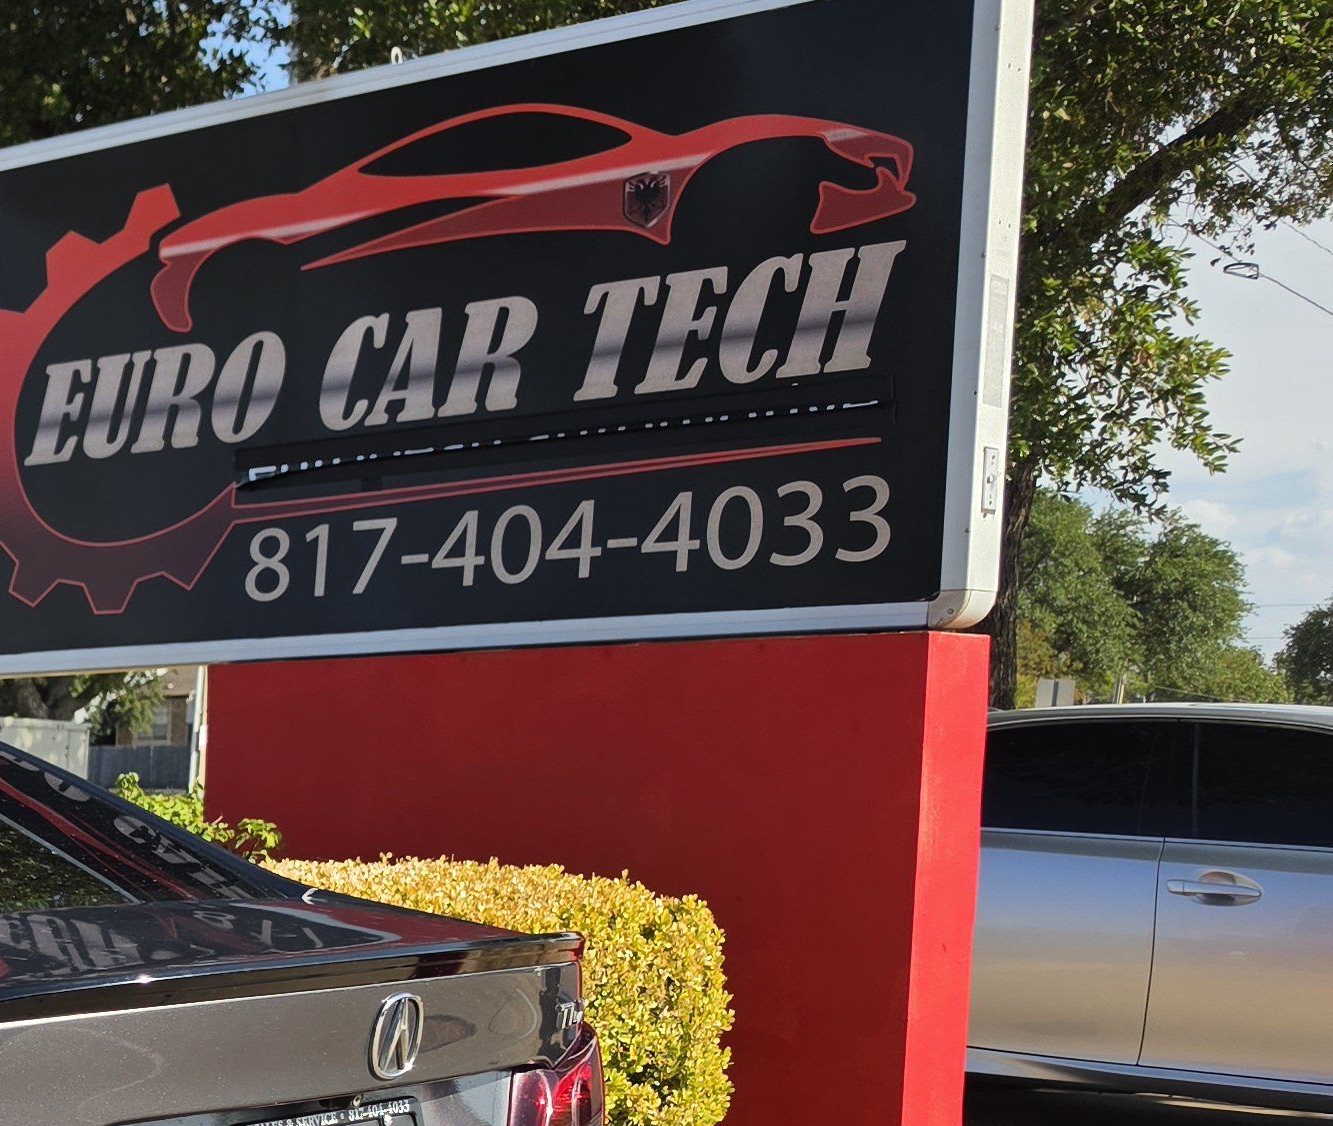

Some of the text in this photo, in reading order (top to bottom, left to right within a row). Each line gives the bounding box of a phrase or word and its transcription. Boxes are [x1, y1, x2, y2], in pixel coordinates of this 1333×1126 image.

[24, 332, 285, 467] EURO
[319, 296, 538, 431] CAR
[573, 239, 907, 402] TECH
[244, 475, 891, 602] 817-404-4033
